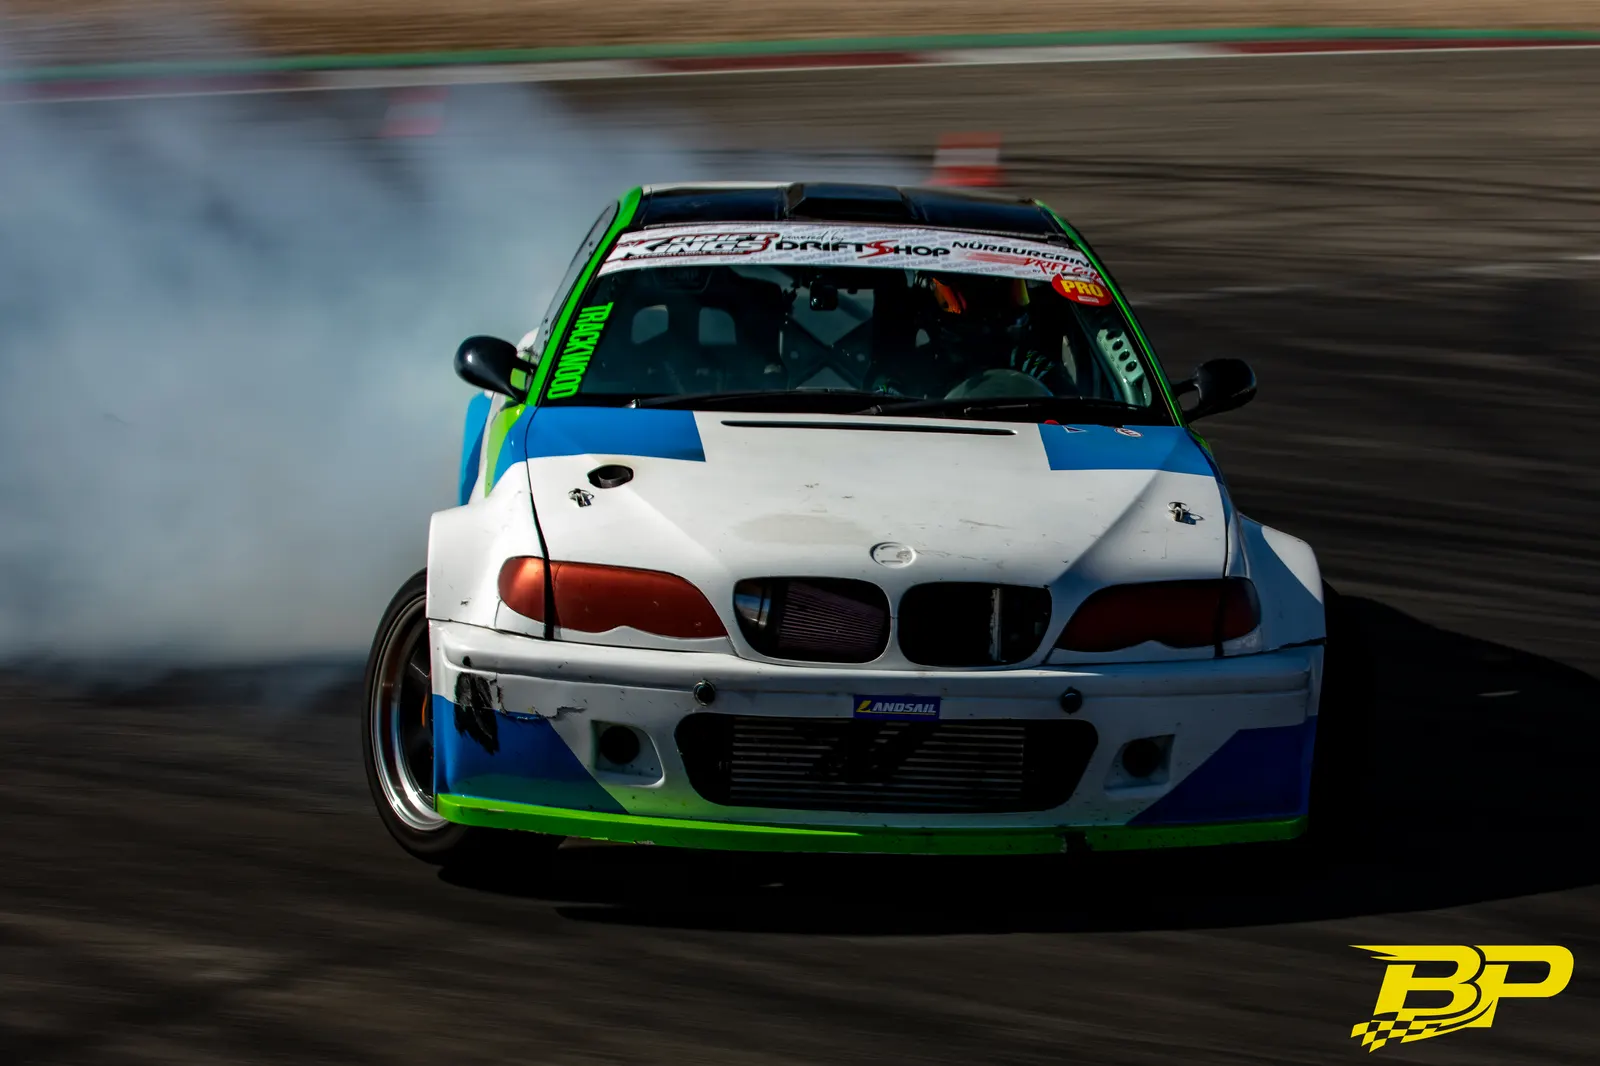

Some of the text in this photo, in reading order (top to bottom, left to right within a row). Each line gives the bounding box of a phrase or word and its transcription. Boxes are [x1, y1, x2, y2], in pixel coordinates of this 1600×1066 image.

[665, 233, 769, 243] DRIFT
[606, 238, 767, 261] KINGS
[952, 240, 1089, 268] NÜRBURGRIN
[1060, 280, 1104, 298] PRO
[547, 302, 614, 400] TRACKWOOD
[856, 700, 936, 714] LANDSAIL
